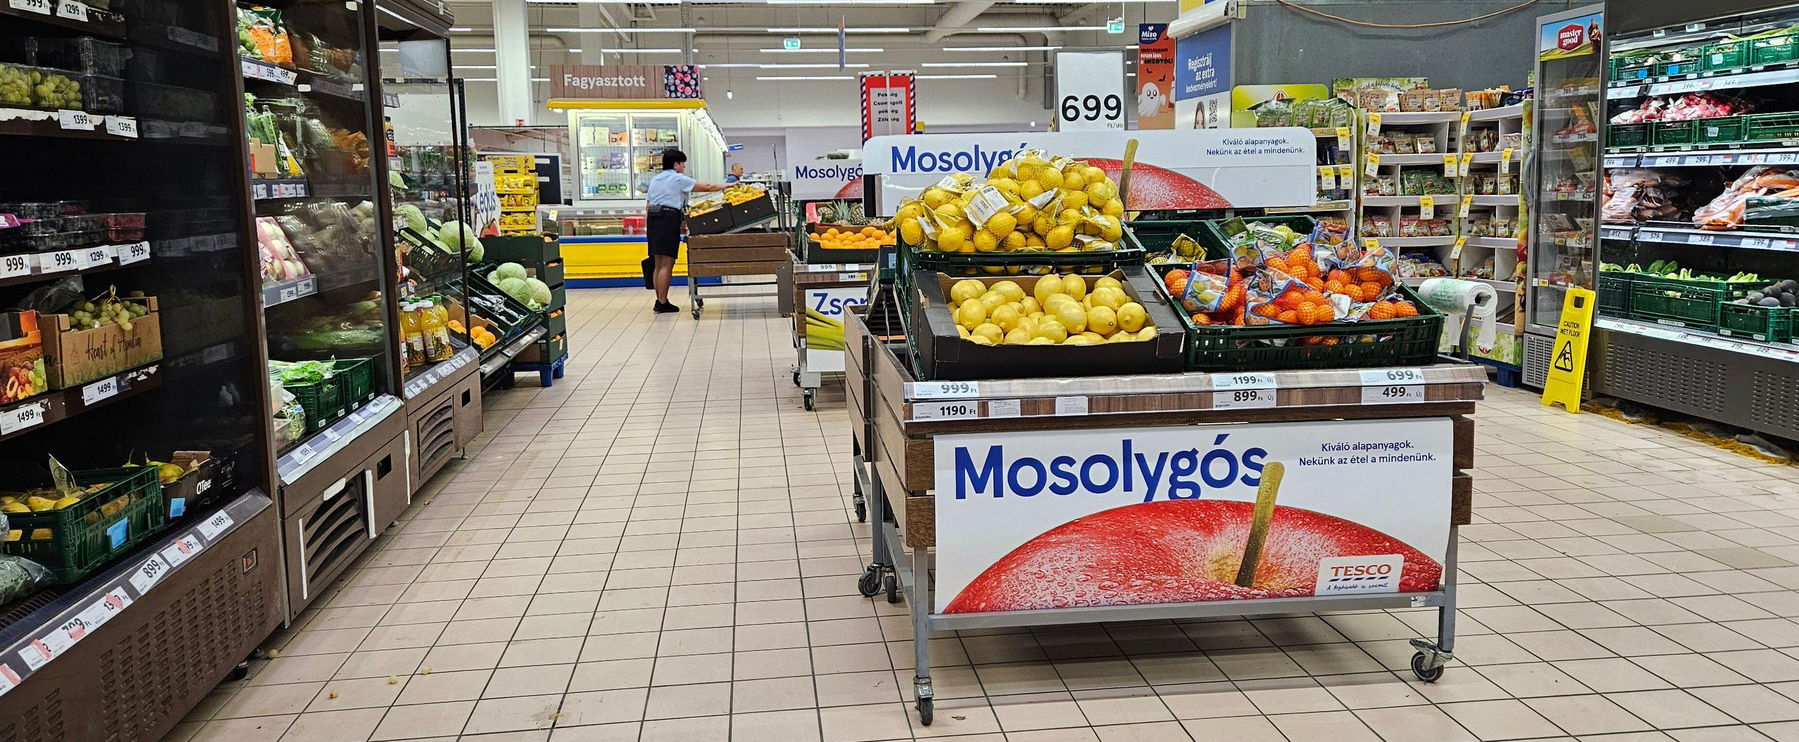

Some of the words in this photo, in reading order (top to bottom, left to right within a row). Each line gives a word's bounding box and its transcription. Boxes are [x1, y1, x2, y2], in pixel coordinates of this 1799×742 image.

[26, 0, 42, 8] 999
[64, 4, 80, 14] 1299
[1560, 29, 1582, 39] master
[1562, 36, 1578, 47] good
[1188, 52, 1212, 72] Regisztrálj
[1196, 71, 1201, 80] az
[1202, 68, 1215, 79] extra
[564, 74, 646, 89] Fagyasztott
[1062, 94, 1122, 122] 699
[73, 114, 87, 124] 1399
[118, 122, 131, 132] 1399
[1245, 138, 1289, 146] alapanyagok.
[90, 250, 104, 262] 1299
[130, 244, 144, 257] 999
[6, 257, 24, 272] 999
[55, 252, 72, 266] 999
[1564, 320, 1580, 329] CAUTION
[85, 332, 107, 362] Heart
[1232, 376, 1257, 385] 1199
[1387, 370, 1414, 381] 699
[97, 382, 111, 394] 1499
[941, 383, 969, 394] 999
[1382, 386, 1406, 398] 499
[1233, 391, 1257, 402] 899
[17, 410, 35, 423] 1499
[940, 406, 966, 416] 1190
[1322, 442, 1350, 452] Kiváló
[1352, 440, 1414, 452] alapanyagok.
[1299, 456, 1335, 466] Nekünk
[1350, 455, 1368, 464] étel
[1379, 452, 1436, 463] mindenünk.
[954, 433, 1268, 502] Mosolygós
[211, 516, 226, 528] 1499
[142, 559, 161, 578] 899
[1331, 564, 1392, 577] TESCO
